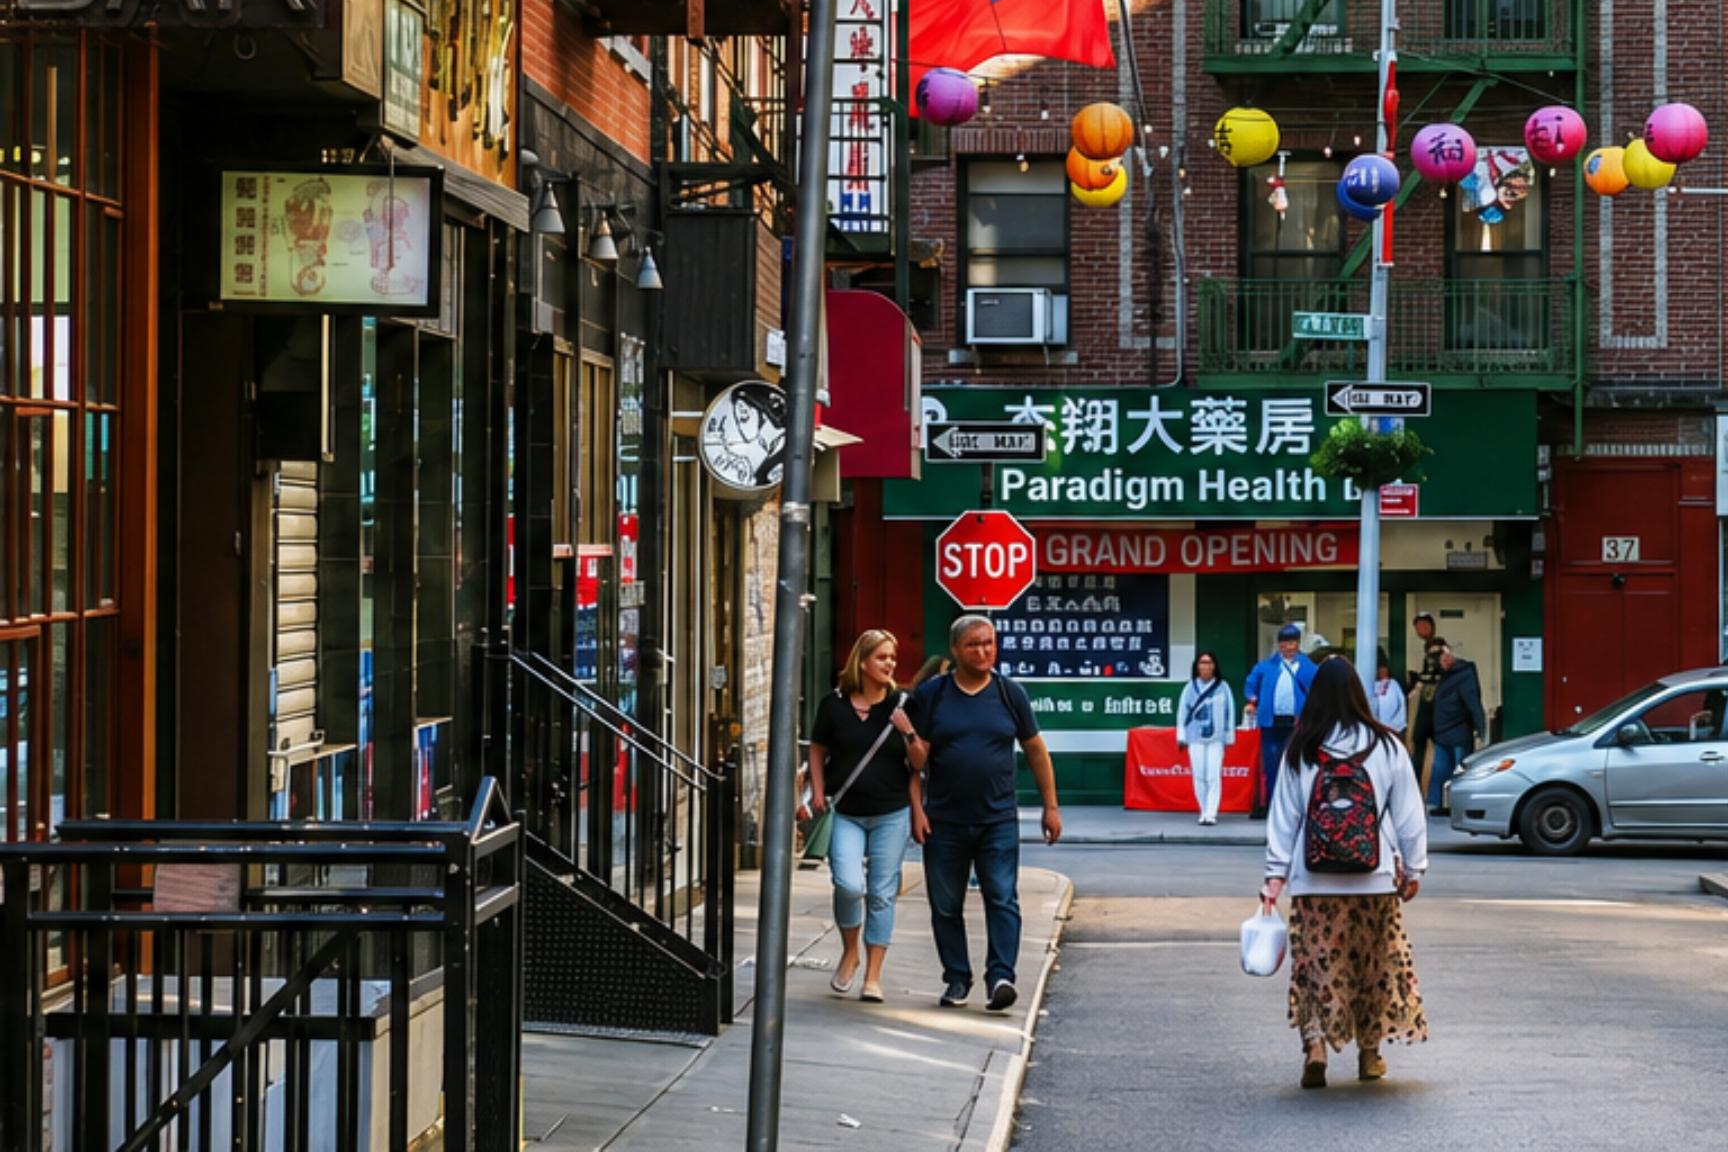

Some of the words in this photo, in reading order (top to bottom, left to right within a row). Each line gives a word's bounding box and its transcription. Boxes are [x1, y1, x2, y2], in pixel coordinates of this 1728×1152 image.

[1001, 467, 1185, 509] Paradigm
[1198, 467, 1327, 502] Health
[943, 543, 1028, 578] STOP
[1045, 534, 1167, 568] GRAND
[1180, 532, 1338, 567] OPENING
[1605, 538, 1636, 562] 37
